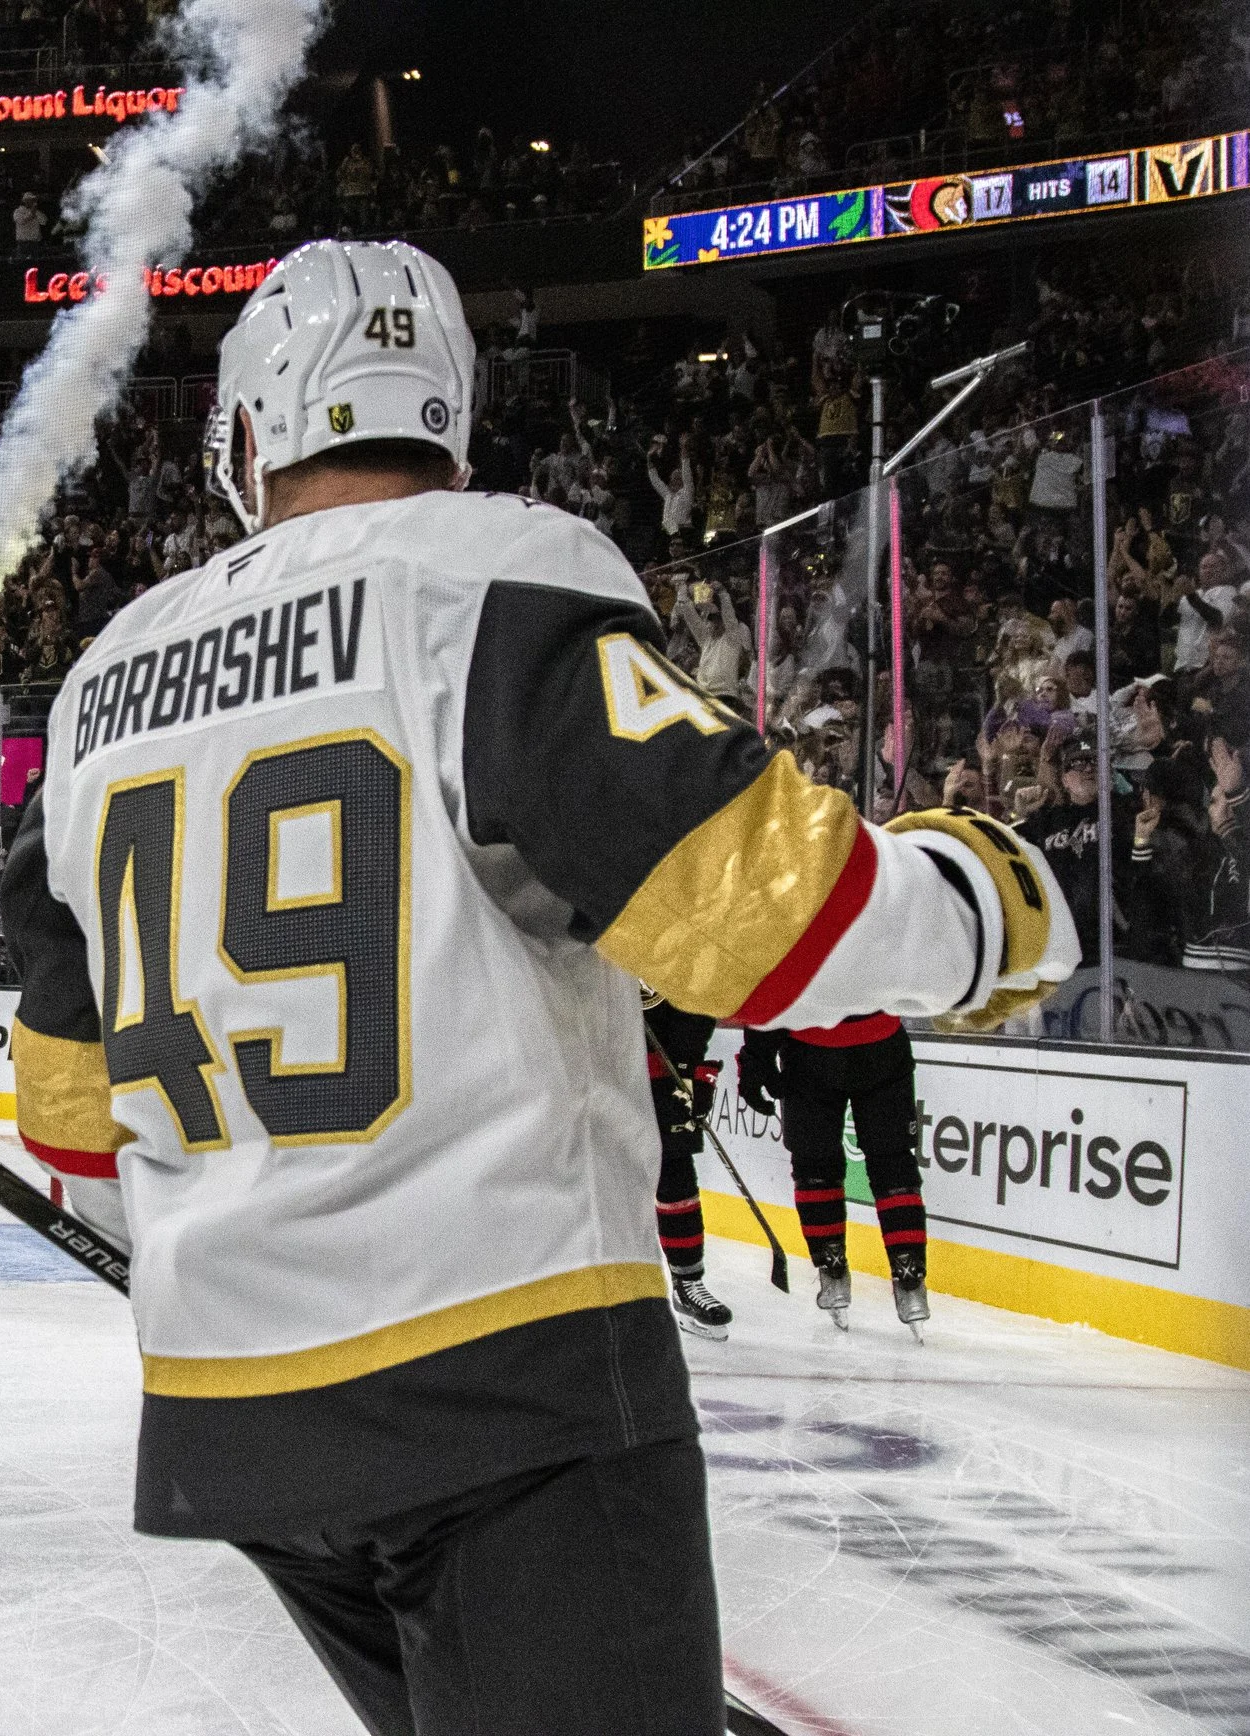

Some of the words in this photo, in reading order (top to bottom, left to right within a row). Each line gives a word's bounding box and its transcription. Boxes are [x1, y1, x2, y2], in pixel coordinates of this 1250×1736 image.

[73, 85, 185, 122] Liquor
[984, 187, 1004, 212] 17
[1028, 178, 1071, 201] HITS
[1099, 169, 1119, 195] 14
[711, 214, 771, 250] 4:24
[778, 202, 819, 242] PM
[142, 257, 278, 296] iscoun
[364, 306, 416, 348] 49
[73, 577, 367, 768] BARBASHEV
[596, 632, 741, 743] 4
[94, 726, 412, 1155] 49
[705, 1088, 783, 1142] ARDS
[49, 1220, 131, 1288] AUER
